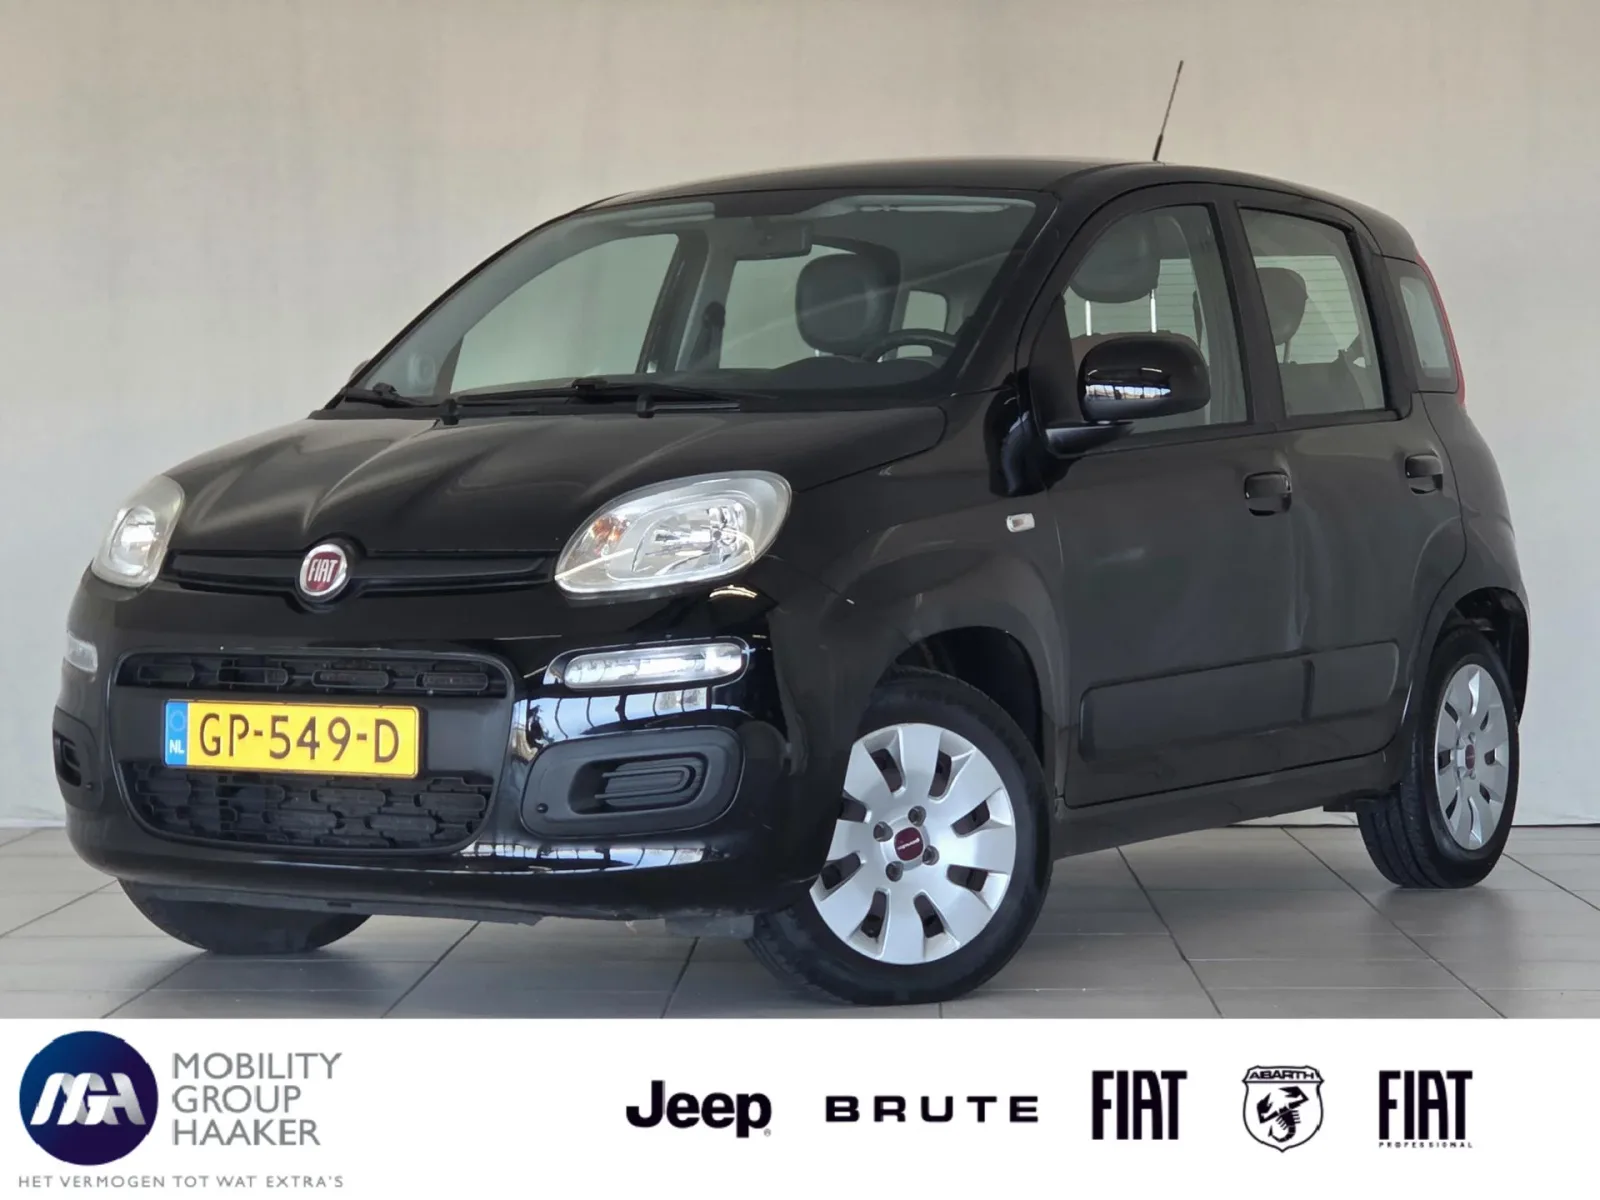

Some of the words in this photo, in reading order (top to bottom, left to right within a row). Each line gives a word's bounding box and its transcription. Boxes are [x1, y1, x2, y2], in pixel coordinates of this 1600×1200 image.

[307, 558, 339, 583] FIAT
[169, 739, 185, 755] NL
[199, 712, 400, 764] GP-549-D
